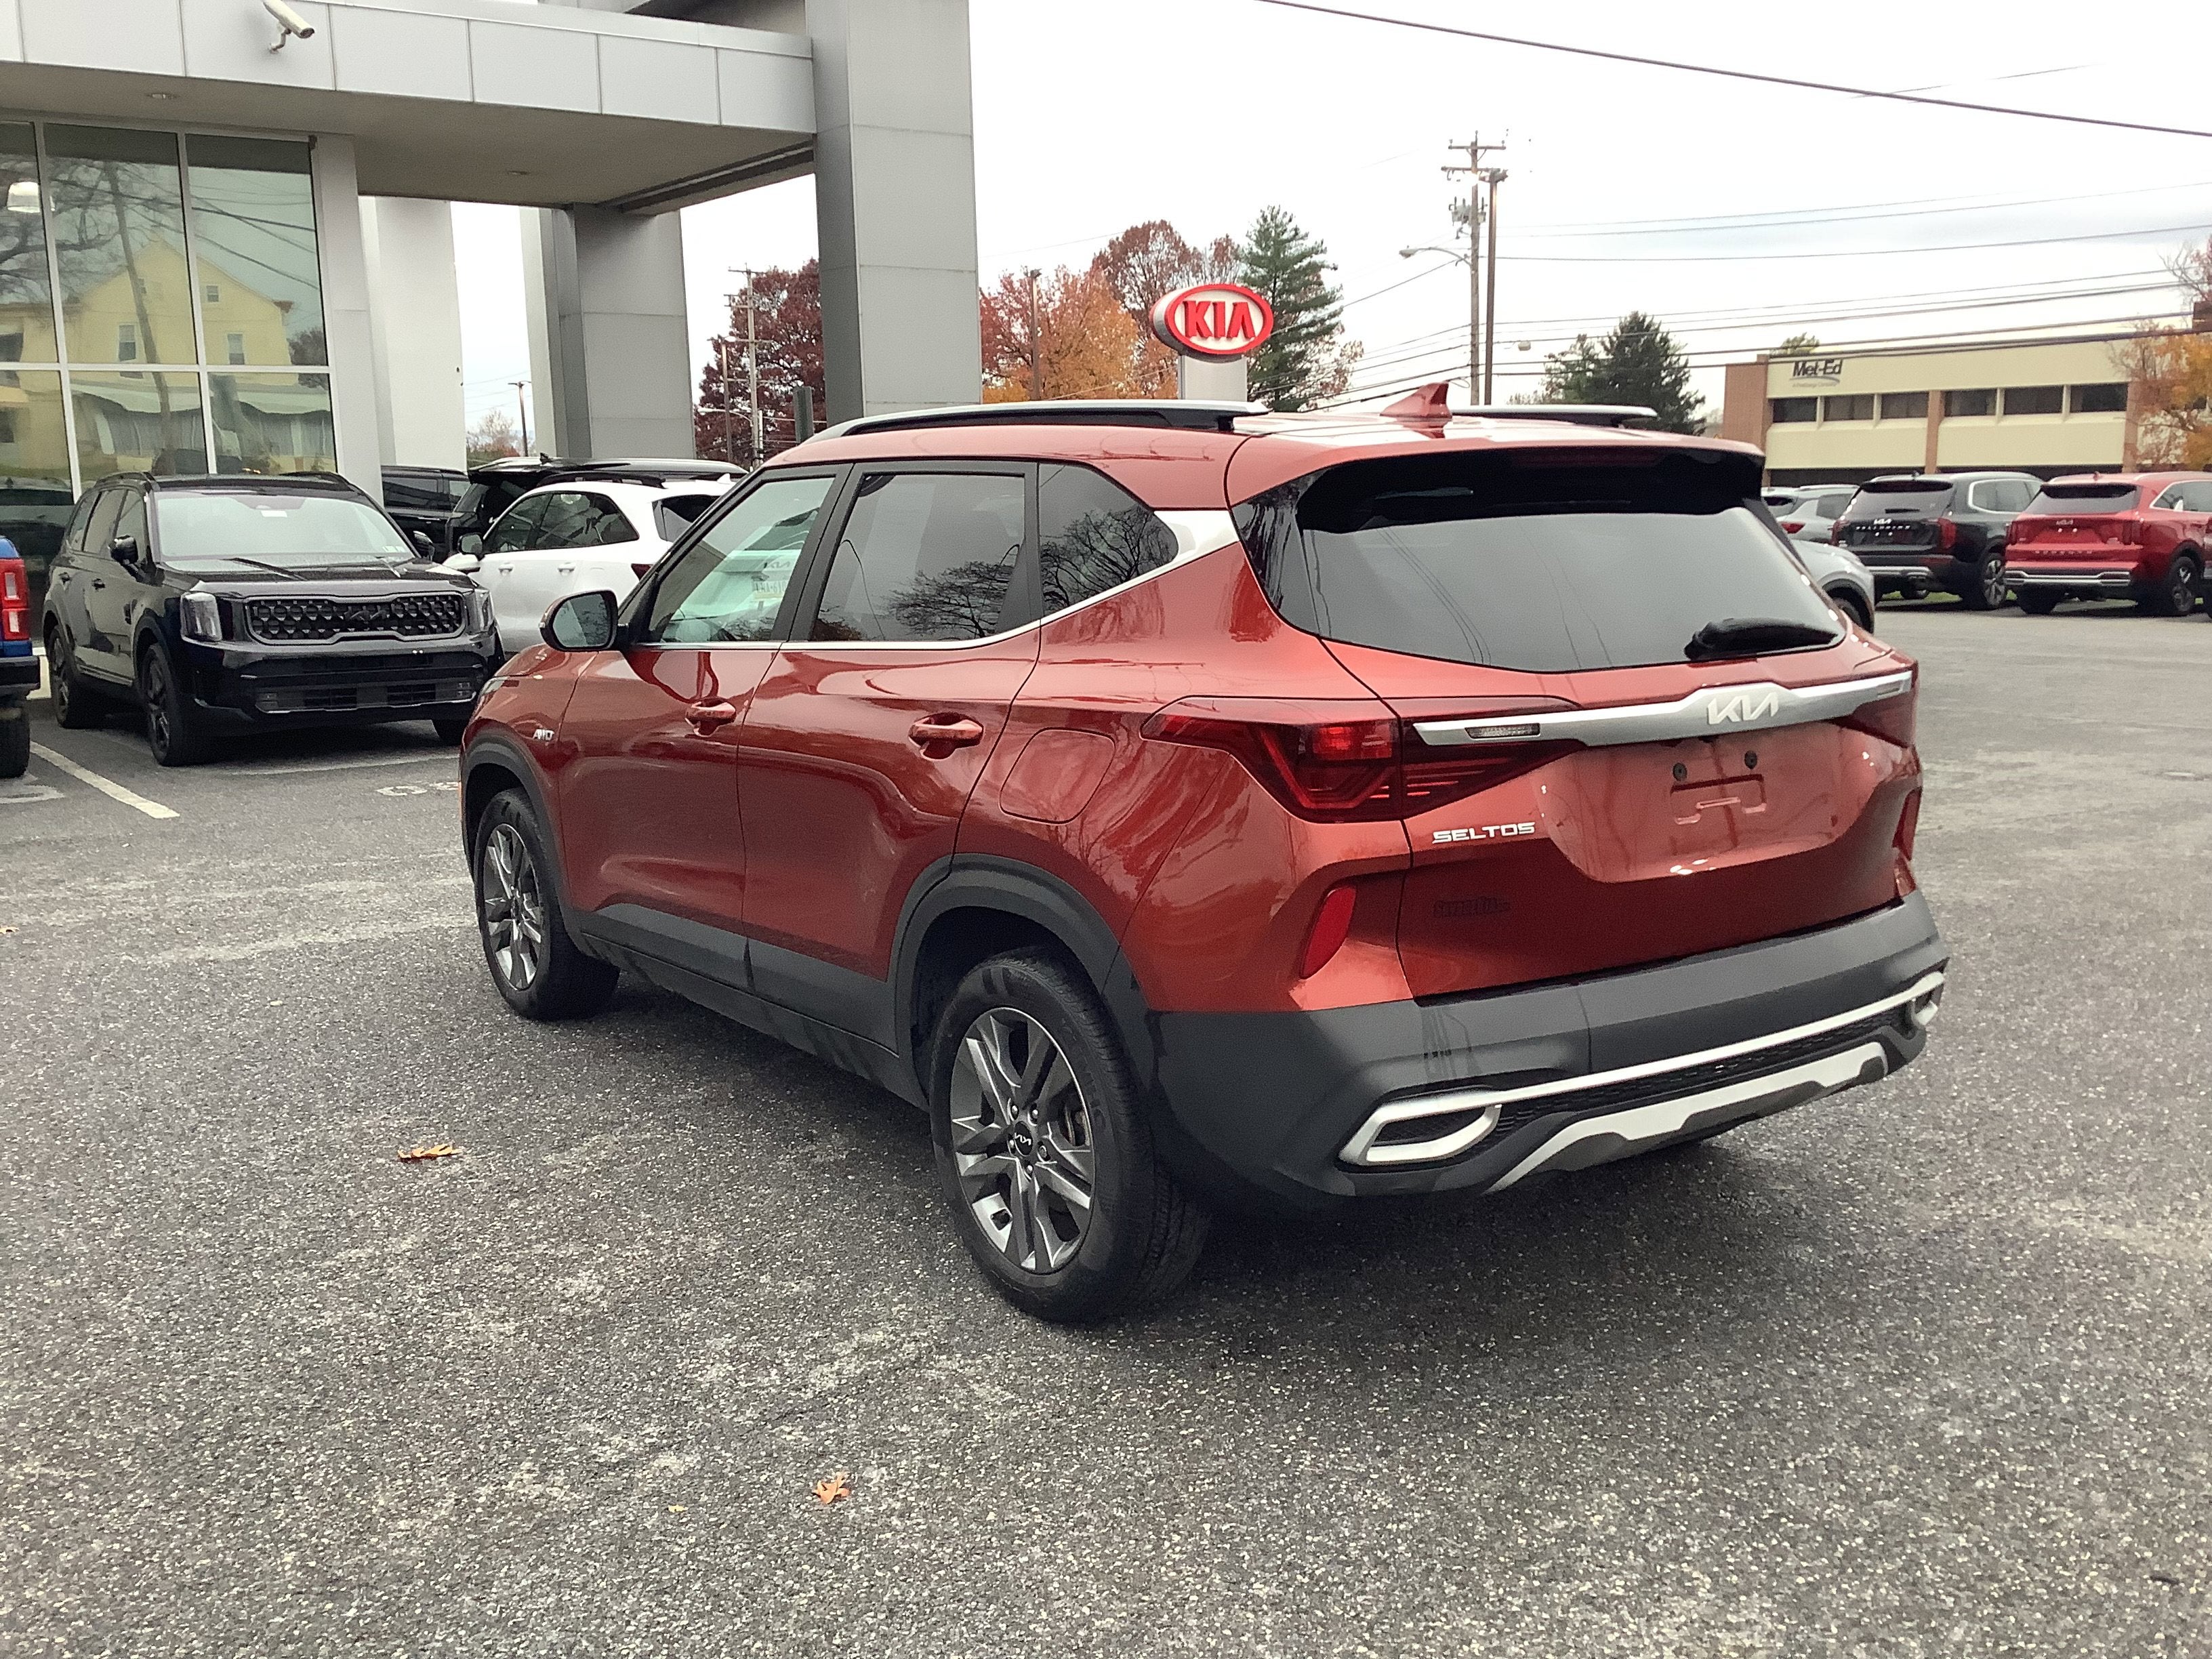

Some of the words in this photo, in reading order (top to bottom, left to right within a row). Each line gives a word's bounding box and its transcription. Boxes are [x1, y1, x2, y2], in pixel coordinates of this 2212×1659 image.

[1183, 300, 1256, 339] KIA
[1793, 359, 1843, 377] Met-Ed
[1707, 691, 1779, 724] KIA
[1432, 821, 1536, 844] SELTOS
